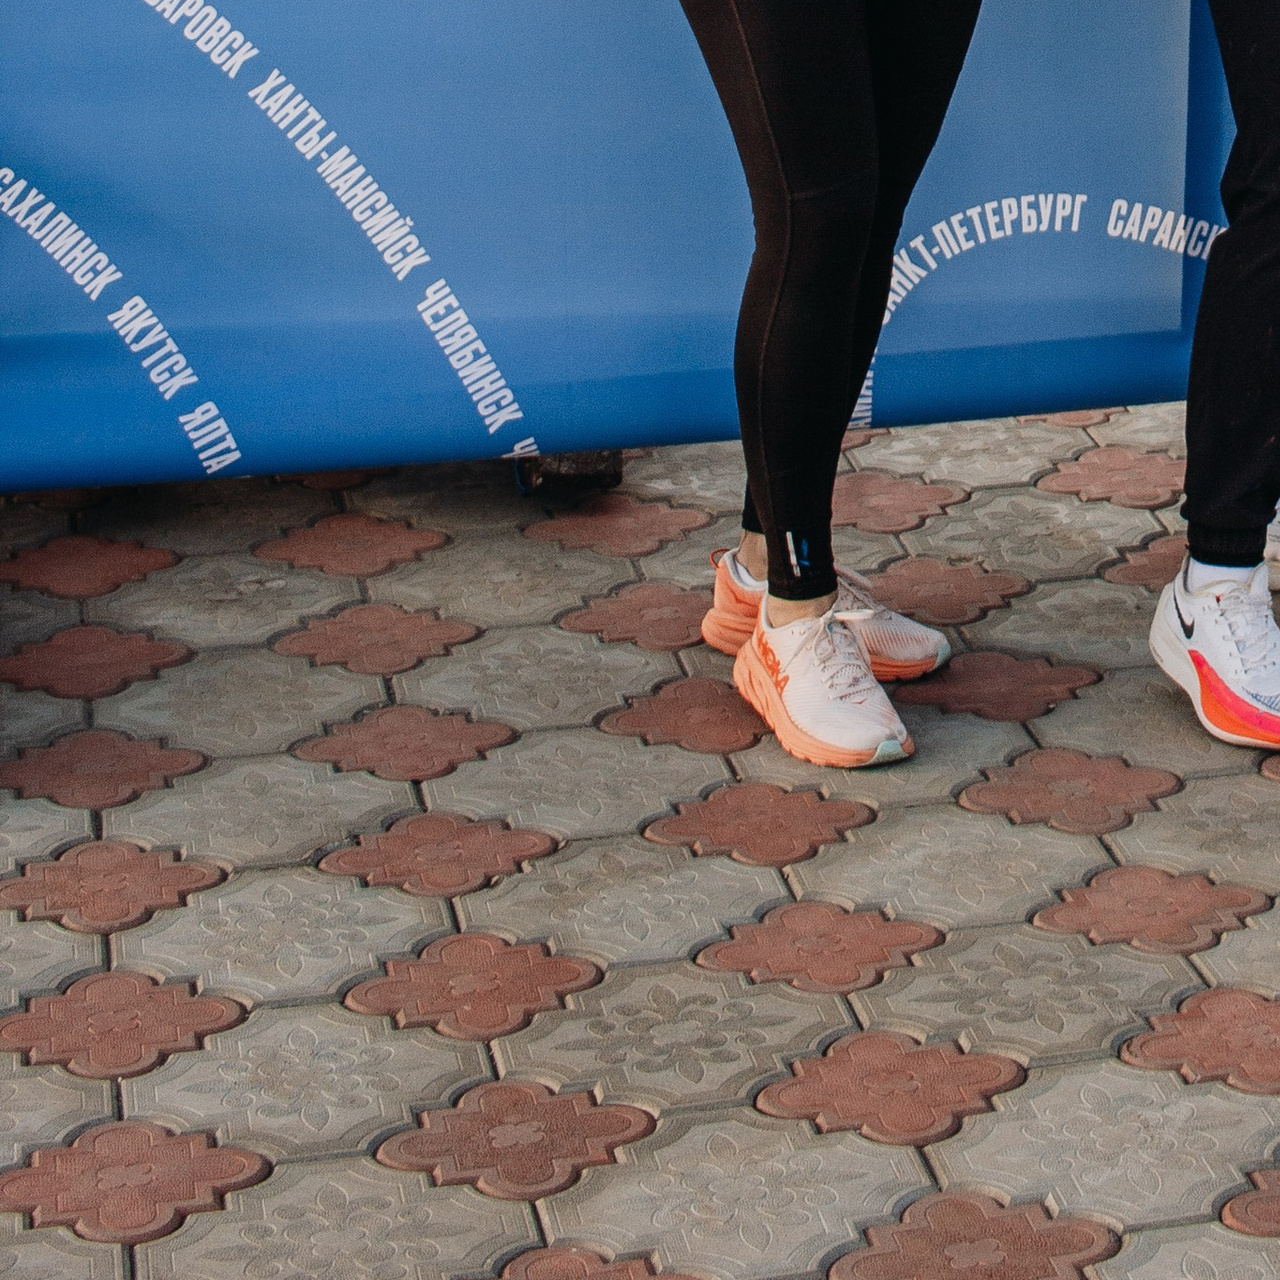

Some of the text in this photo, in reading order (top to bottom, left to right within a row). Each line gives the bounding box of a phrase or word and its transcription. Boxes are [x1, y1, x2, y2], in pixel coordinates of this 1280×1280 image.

[248, 68, 431, 281] ХАНТЫ-МАНСИЙСК
[416, 278, 523, 435] ЧЕЛЯБИНСК
[882, 193, 1088, 326] АНКТ-ПЕТЕРБУРГ
[107, 295, 200, 401] ЯКУТСК
[178, 401, 242, 475] ЯЛТА
